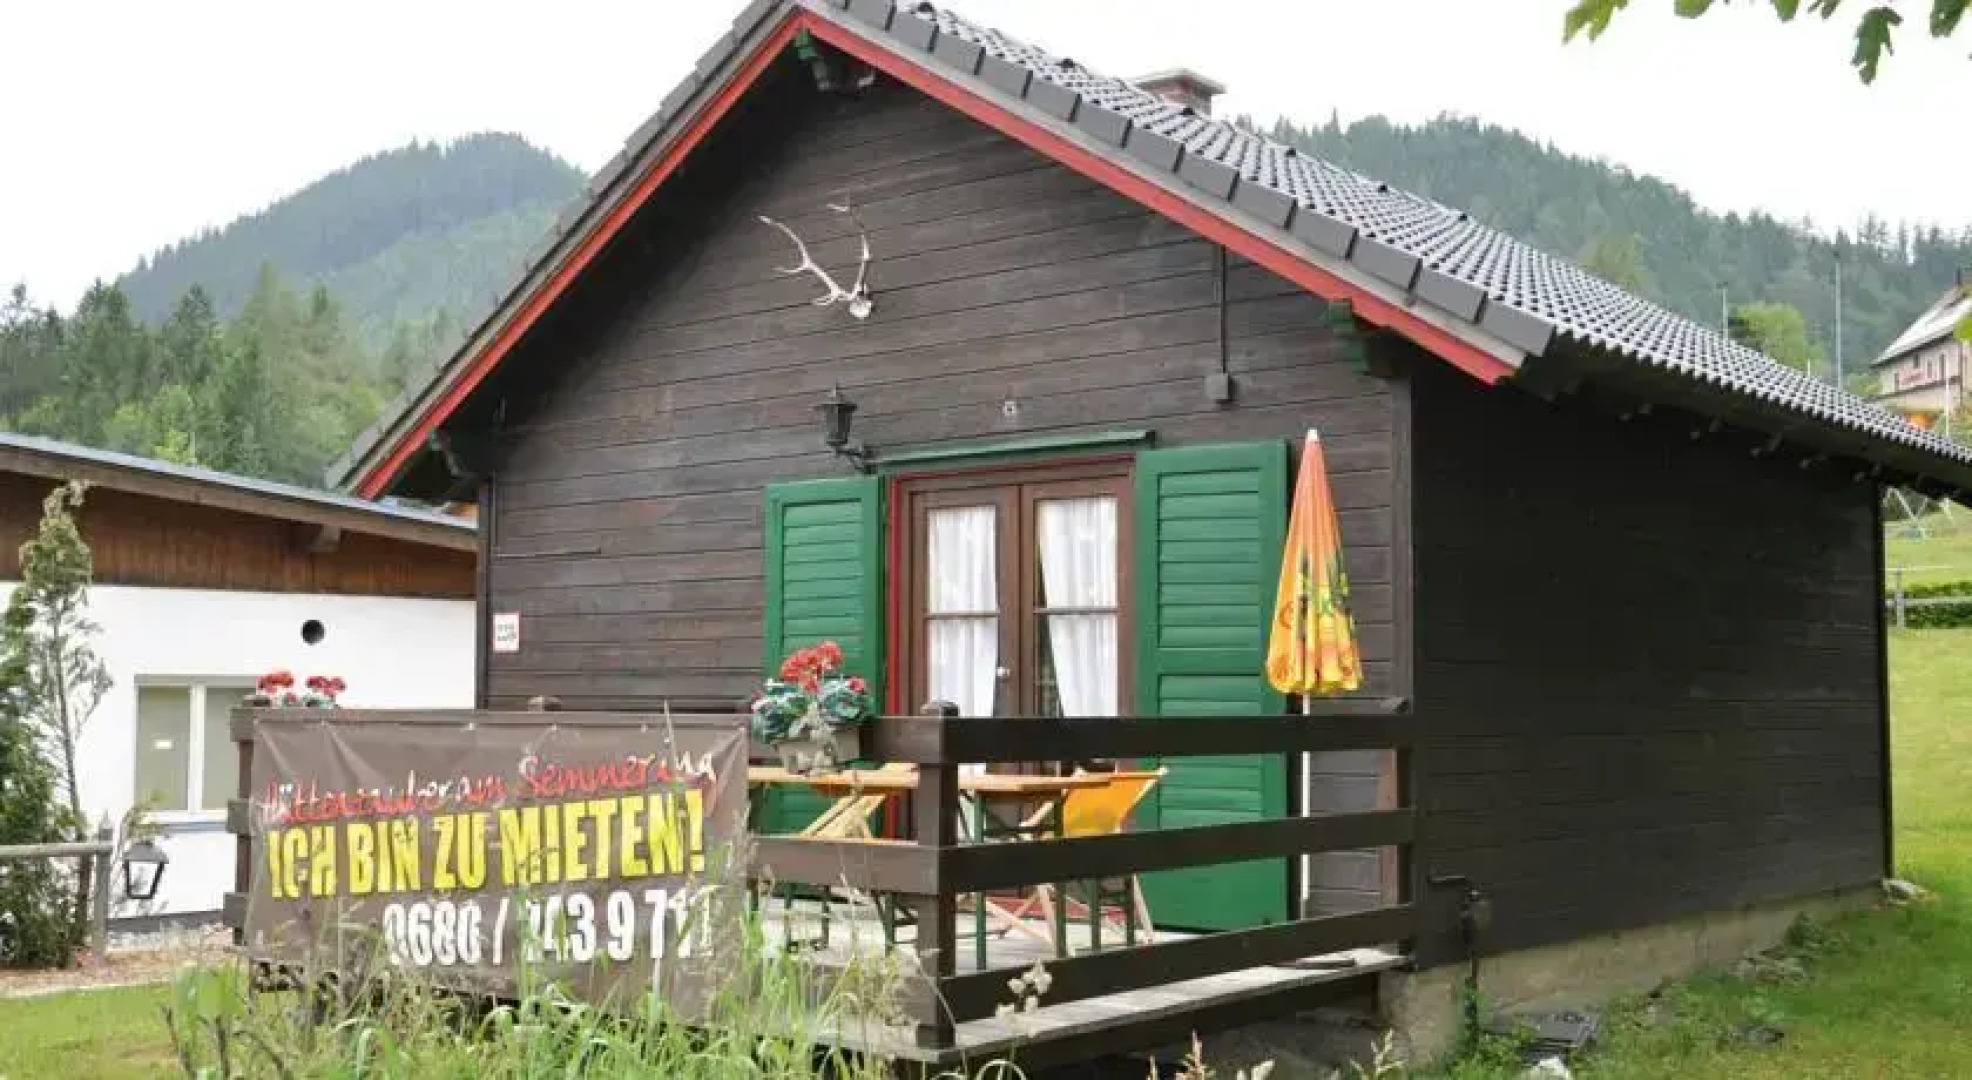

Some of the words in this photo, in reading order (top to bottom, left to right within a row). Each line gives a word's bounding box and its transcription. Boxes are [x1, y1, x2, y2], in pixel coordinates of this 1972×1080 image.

[518, 750, 718, 812] Semmering
[267, 826, 338, 898] ICH
[348, 816, 421, 893] BIN
[432, 812, 490, 889] ZU
[499, 789, 706, 886] MIETEN!
[383, 900, 482, 966] 0680
